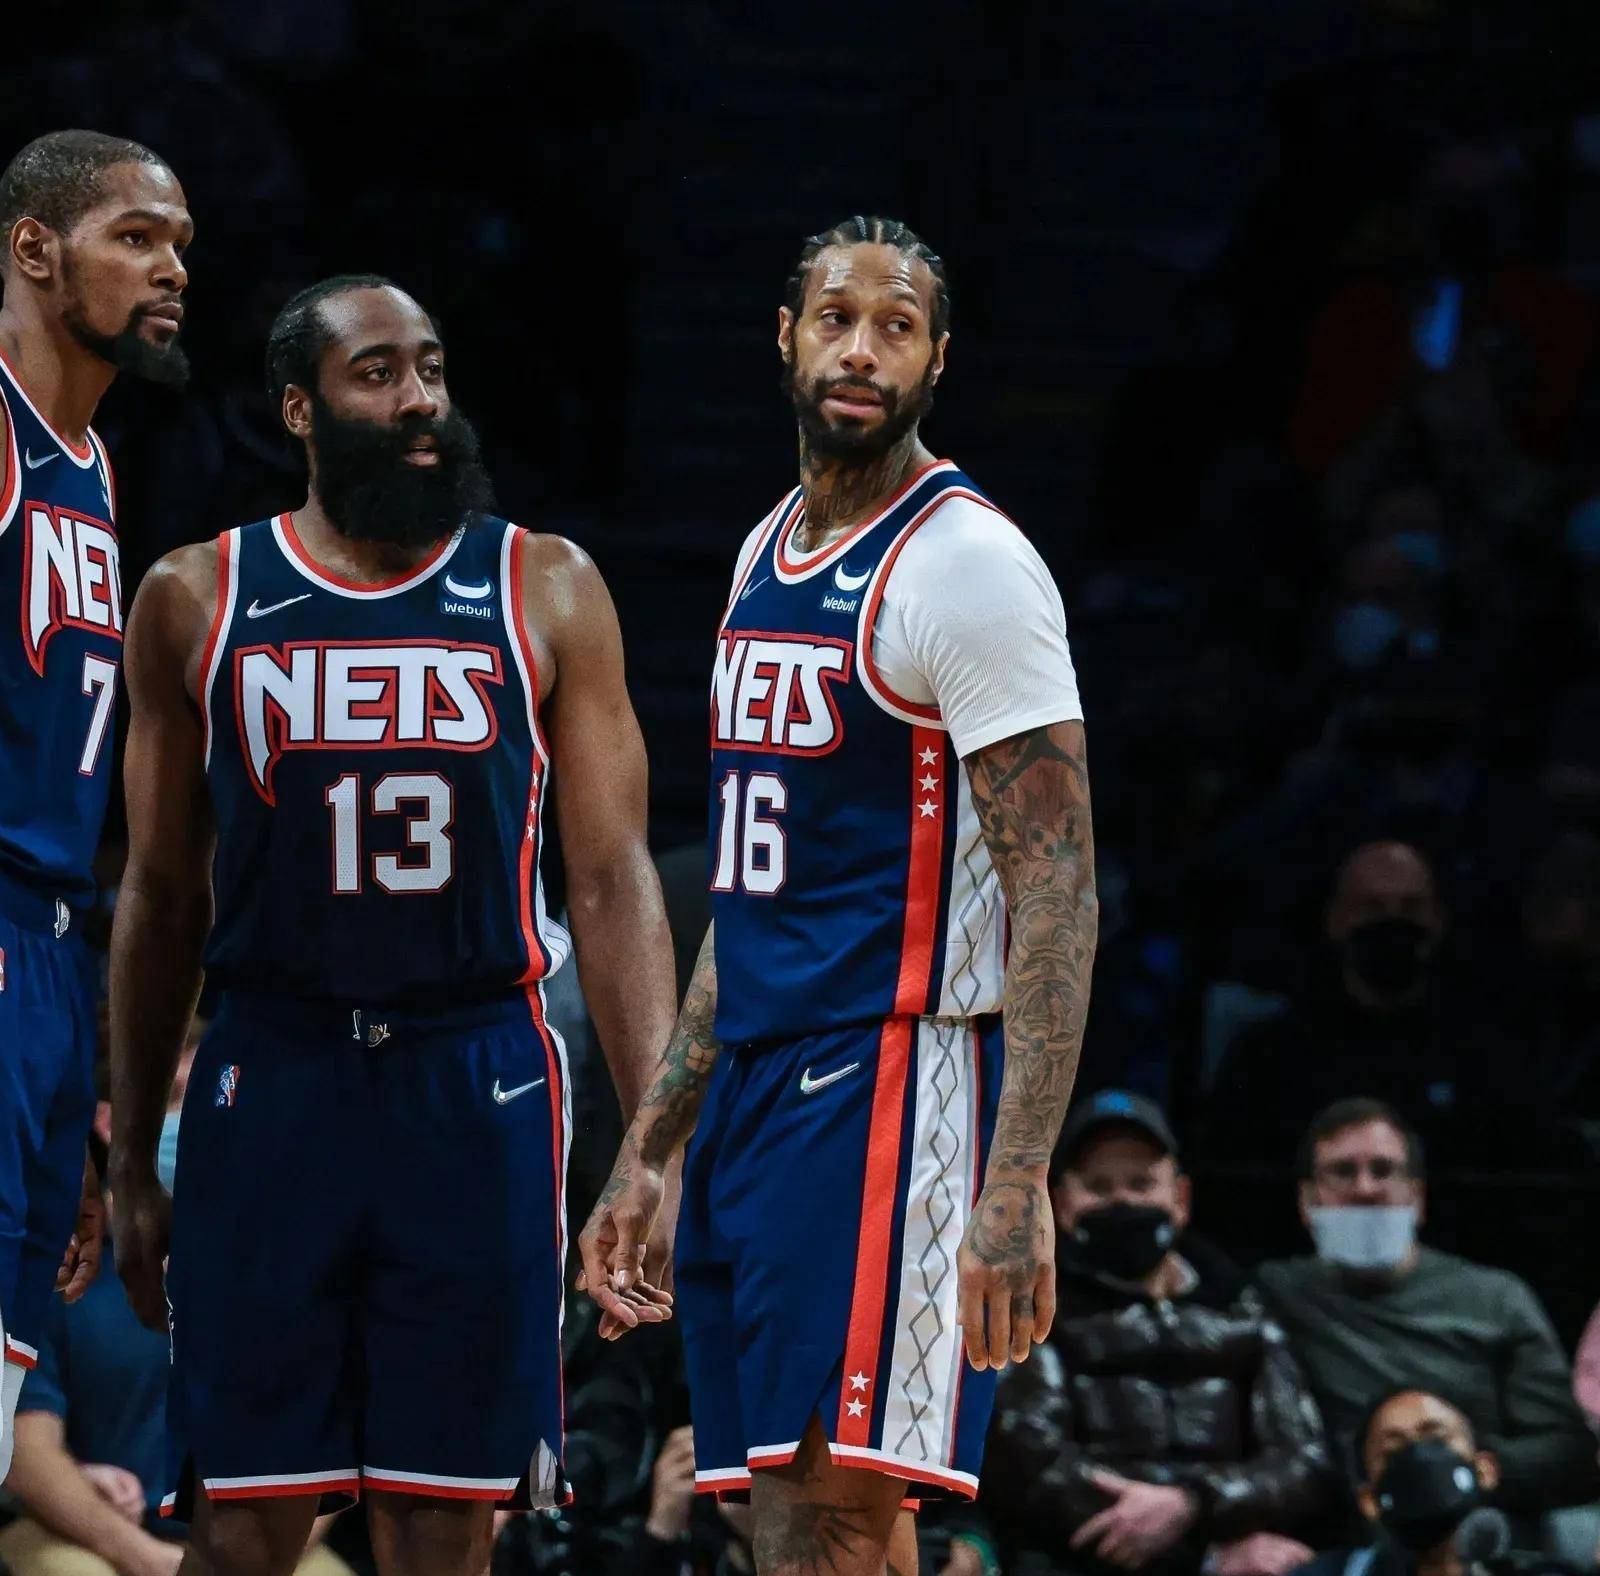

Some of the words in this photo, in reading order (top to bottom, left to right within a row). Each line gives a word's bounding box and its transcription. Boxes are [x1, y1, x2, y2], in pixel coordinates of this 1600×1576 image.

[21, 500, 123, 678] NET
[444, 601, 491, 618] Webull
[822, 595, 857, 612] Webull
[79, 651, 118, 776] 7
[234, 638, 504, 808] NETS
[325, 771, 454, 895] 13
[710, 769, 788, 896] 16
